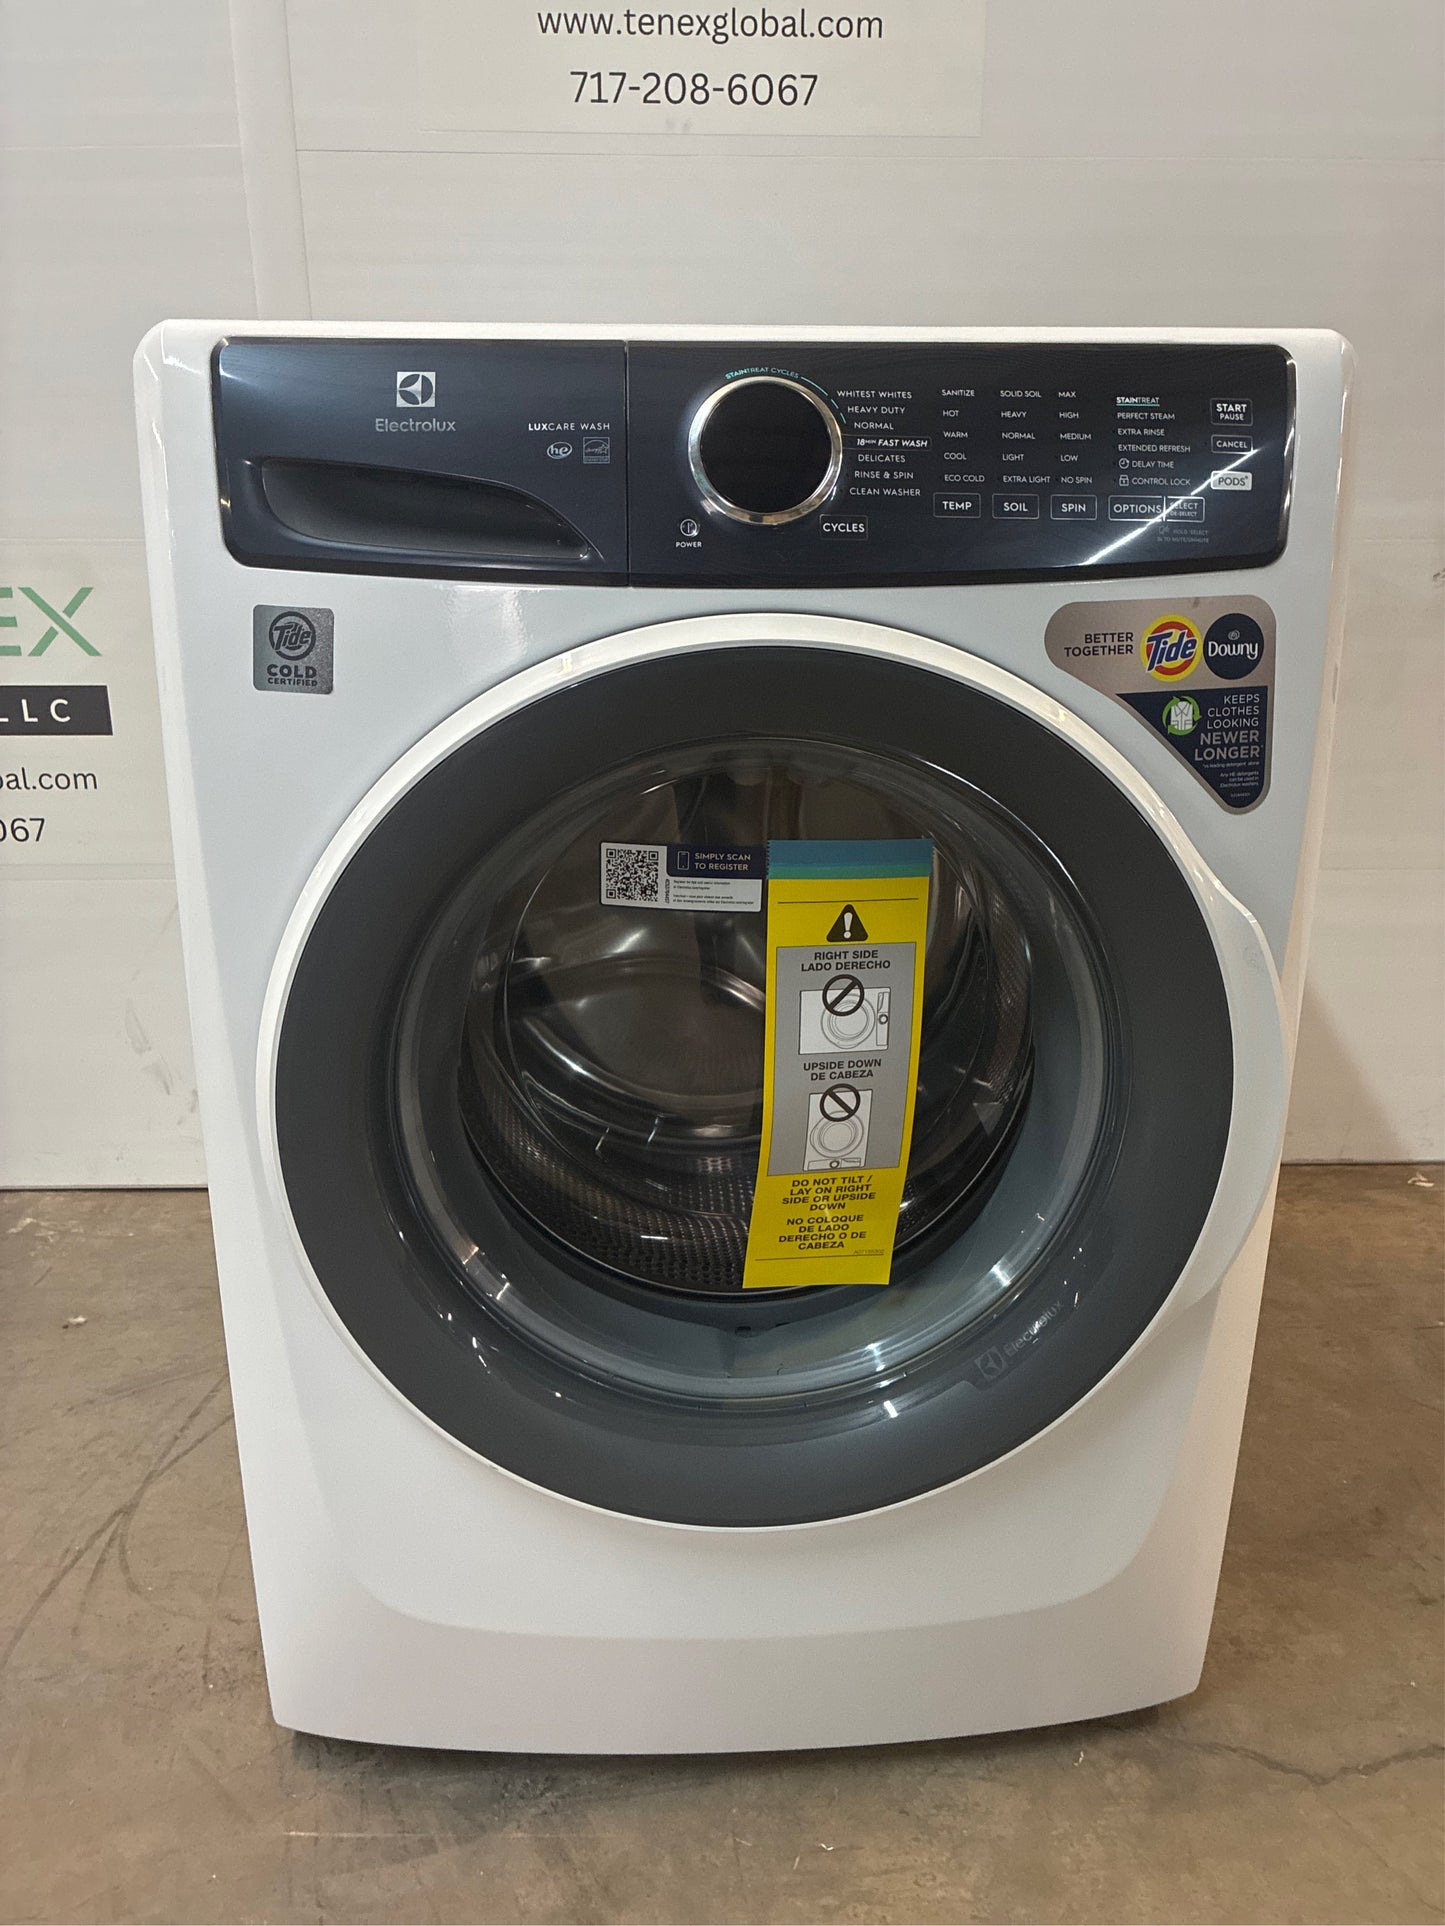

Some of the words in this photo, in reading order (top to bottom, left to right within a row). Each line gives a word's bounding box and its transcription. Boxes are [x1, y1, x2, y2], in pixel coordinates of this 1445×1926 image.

[537, 8, 883, 44] www.tenexglobal.com
[570, 71, 818, 106] 717-208-6067
[725, 367, 769, 380] STAINTREAT
[770, 367, 799, 379] CYCLES
[837, 390, 876, 398] WHITEST
[878, 391, 912, 399] WHITES
[942, 389, 976, 397] SANITIZE
[1000, 390, 1023, 398] SOLID
[1024, 390, 1042, 398] SOIL
[1116, 396, 1160, 404] STAINTREAT
[847, 406, 878, 414] HEAVY
[880, 406, 906, 414] DUTY
[1216, 404, 1247, 412] START
[1059, 411, 1080, 419] HIGH
[1117, 412, 1148, 420] PERFECT
[1150, 412, 1176, 420] STEAM
[375, 418, 456, 432] Electrolux
[528, 422, 576, 432] LUXCARE
[580, 422, 610, 431] WASH
[854, 422, 894, 430] NORMAL
[1002, 432, 1036, 440] NORMAL
[1118, 428, 1142, 436] EXTRA
[1144, 428, 1165, 436] RINSE
[878, 439, 900, 447] FAST
[1216, 440, 1247, 448] CANCEL
[1118, 444, 1157, 452] EXTENDED
[1159, 445, 1191, 453] REFRESH
[858, 454, 906, 462] DELICATES
[944, 452, 967, 460] COOL
[1060, 454, 1078, 462] LOW
[1157, 461, 1174, 469] TIME
[854, 470, 880, 478] RINSE
[883, 471, 890, 479] &
[893, 471, 914, 479] SPIN
[944, 474, 961, 482] ECO
[1003, 475, 1027, 483] EXTRA
[1061, 476, 1074, 484] NO
[1132, 477, 1168, 485] CONTROL
[1170, 478, 1191, 486] LOCK
[849, 487, 880, 495] CLEAN
[883, 488, 920, 496] WASHER
[942, 501, 972, 510] TEMP
[1003, 502, 1028, 511] SOIL
[1061, 503, 1086, 512] SPIN
[1113, 504, 1162, 513] OPTIONS
[822, 522, 865, 533] CYCLES
[273, 622, 312, 650] Tide
[1084, 632, 1134, 644] BETTER
[1064, 644, 1134, 657] TOGETHER
[1146, 630, 1198, 673] Tide
[1208, 641, 1259, 660] Downy
[267, 664, 317, 678] COLD
[267, 678, 318, 687] CERTIFIED
[1224, 694, 1260, 705] KEEPS
[1207, 705, 1260, 717] CLOTHES
[1207, 718, 1259, 729] LOOKING
[1200, 730, 1259, 745] NEWER
[695, 852, 725, 861] SIMPLY
[727, 853, 751, 861] SCAN
[695, 862, 706, 870] TO
[709, 863, 748, 871] REGISTER
[814, 951, 849, 961] RIGHT
[852, 950, 879, 959] SIDE
[801, 961, 832, 972] LADO
[835, 960, 891, 970] DERECHO
[803, 1061, 844, 1071] UPSIDE
[848, 1059, 882, 1068] DOWN
[810, 1072, 826, 1081] DE
[829, 1070, 874, 1080] CABEZA
[792, 1179, 809, 1187] DO
[812, 1178, 838, 1186] NOT
[841, 1176, 864, 1184] TILT
[790, 1188, 812, 1196] LAY
[815, 1186, 832, 1194] ON
[835, 1184, 872, 1193] RIGHT
[782, 1196, 809, 1205] SIDE
[812, 1195, 830, 1203] OR
[833, 1192, 876, 1201] UPSIDE
[810, 1202, 846, 1211] DOWN
[786, 1217, 803, 1226] NO
[807, 1215, 864, 1224] COLOQUE
[798, 1225, 815, 1233] DE
[818, 1223, 850, 1232] LADO
[778, 1233, 835, 1242] DERECHO
[851, 1231, 867, 1239] DE
[798, 1241, 845, 1250] CABEZA
